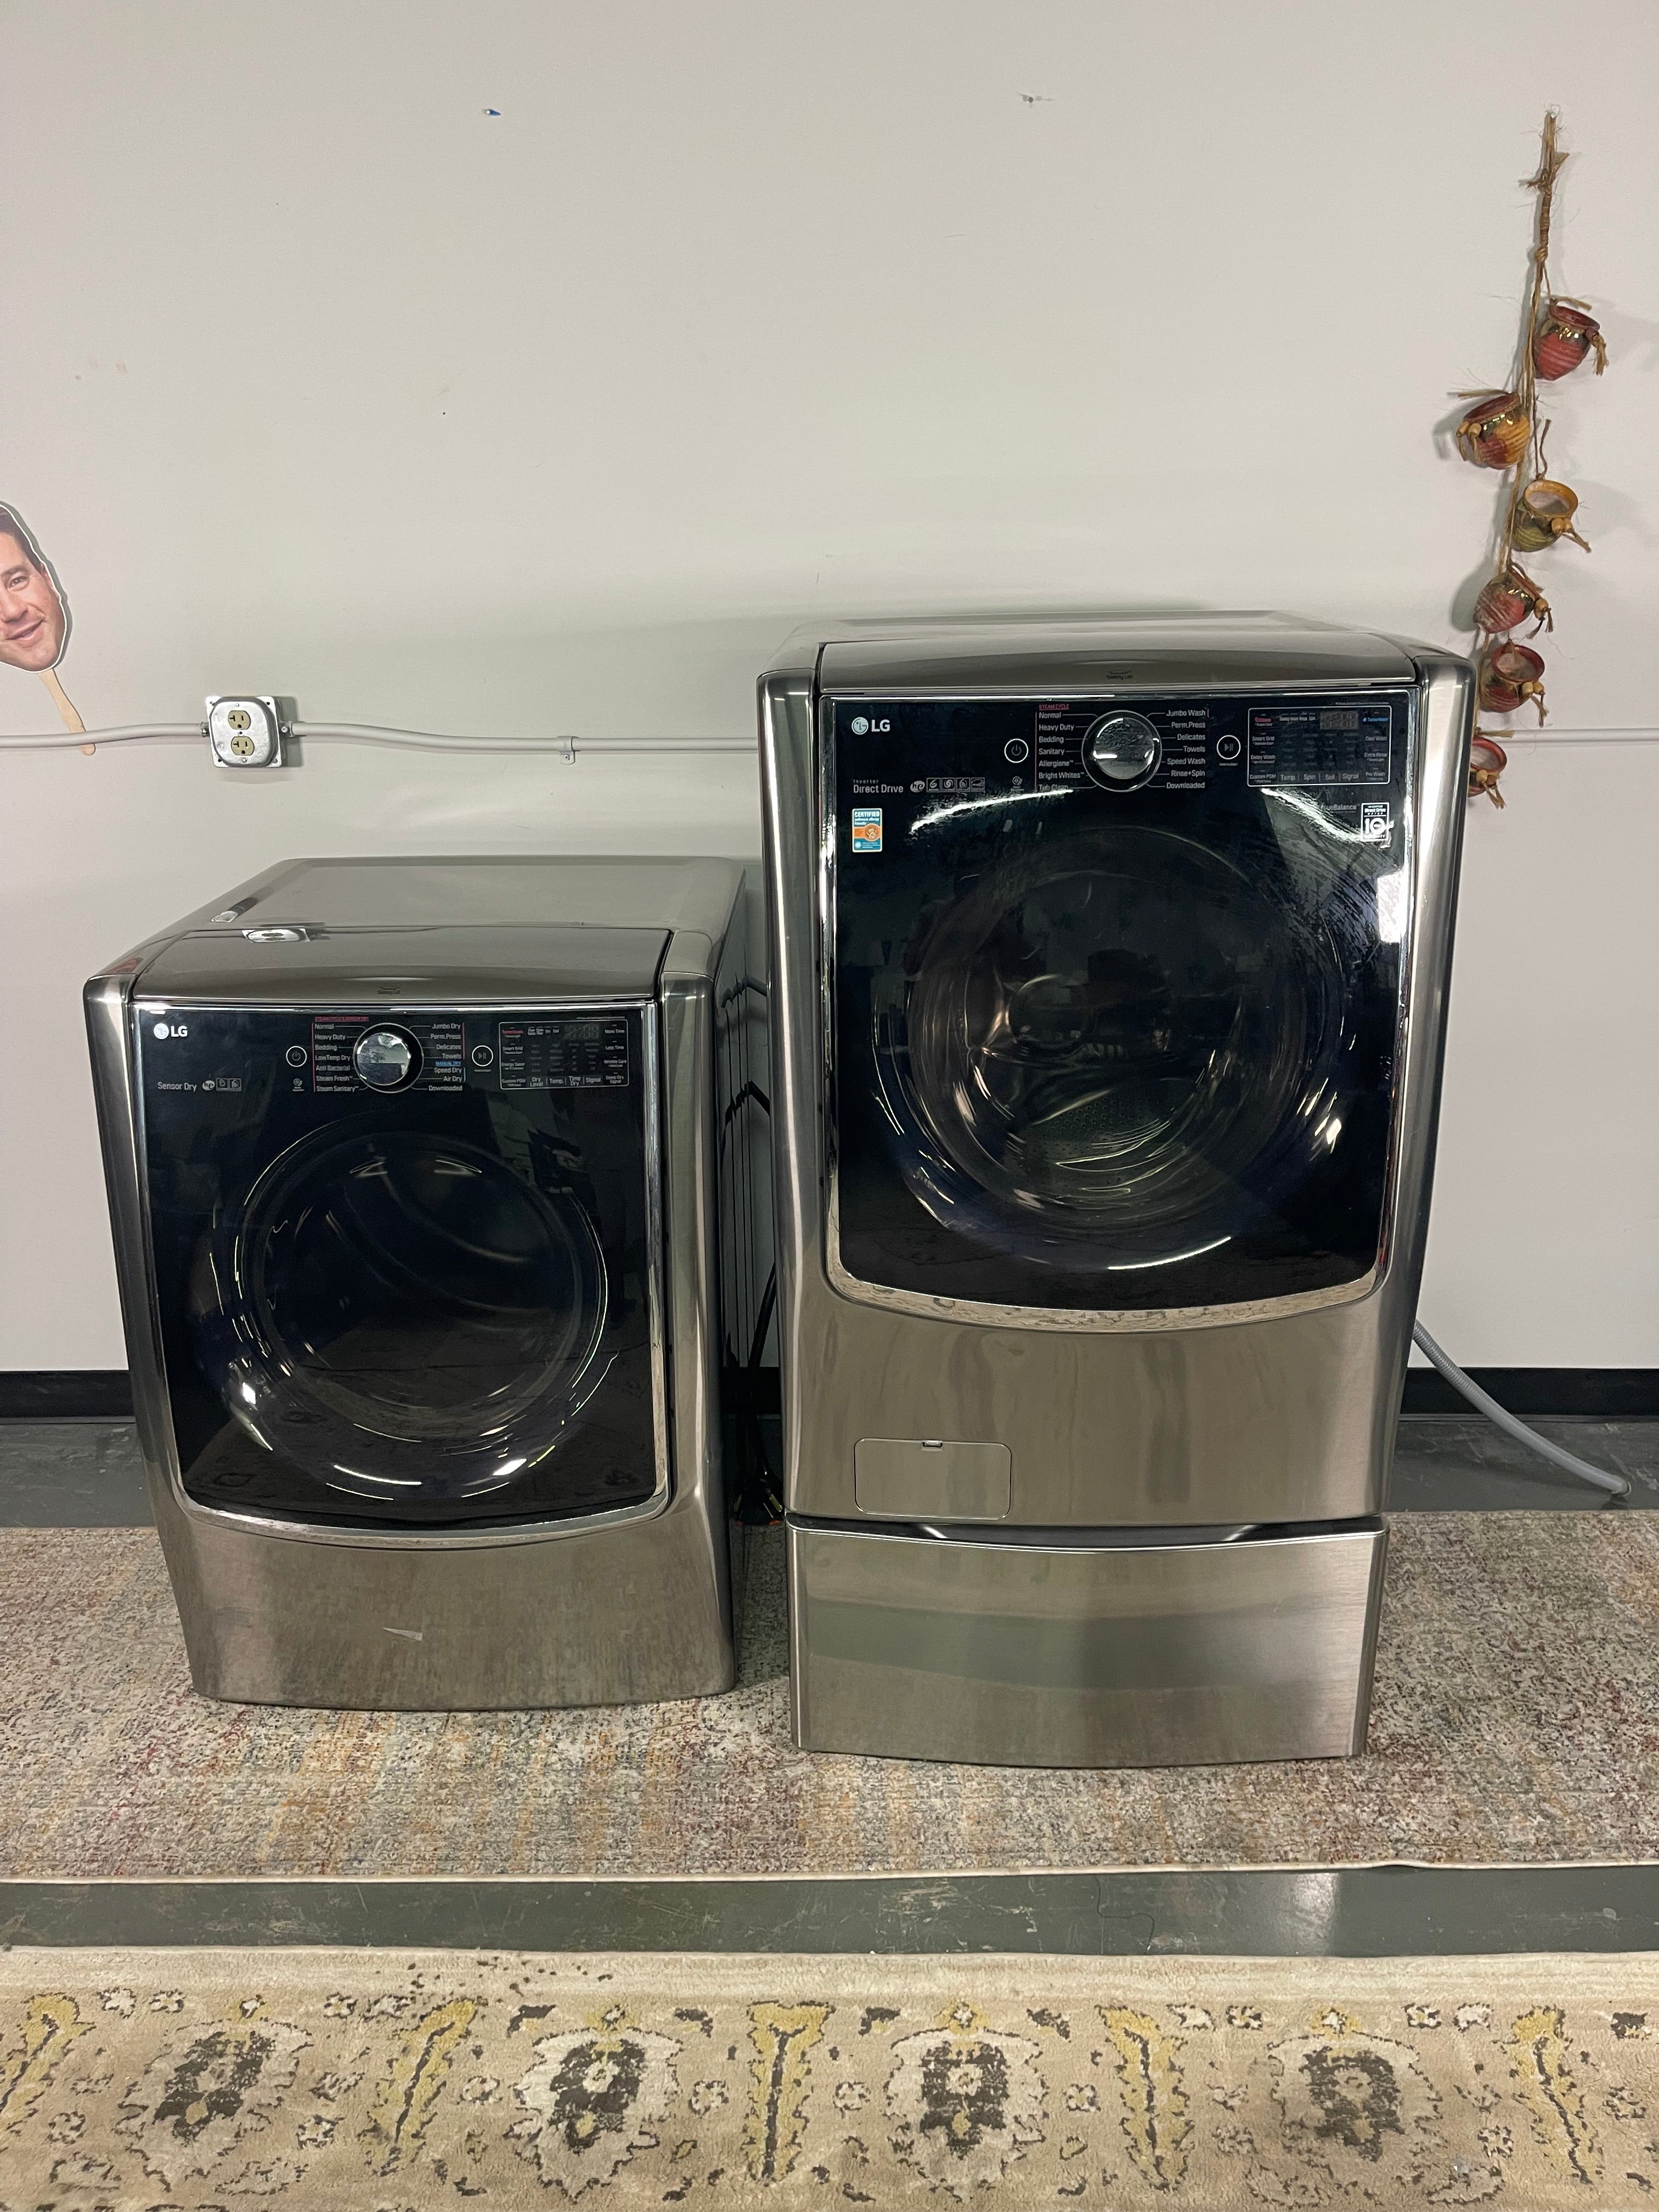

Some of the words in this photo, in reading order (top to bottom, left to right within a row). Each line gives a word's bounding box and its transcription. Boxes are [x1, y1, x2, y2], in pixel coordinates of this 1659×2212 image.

[871, 719, 890, 732] LG
[1039, 772, 1058, 780] Bright
[1342, 773, 1359, 781] Signal
[853, 784, 879, 793] Direct
[881, 784, 904, 793] Drive
[171, 1025, 188, 1037] LG
[157, 1081, 183, 1090] Sensor
[184, 1082, 198, 1092] Dry
